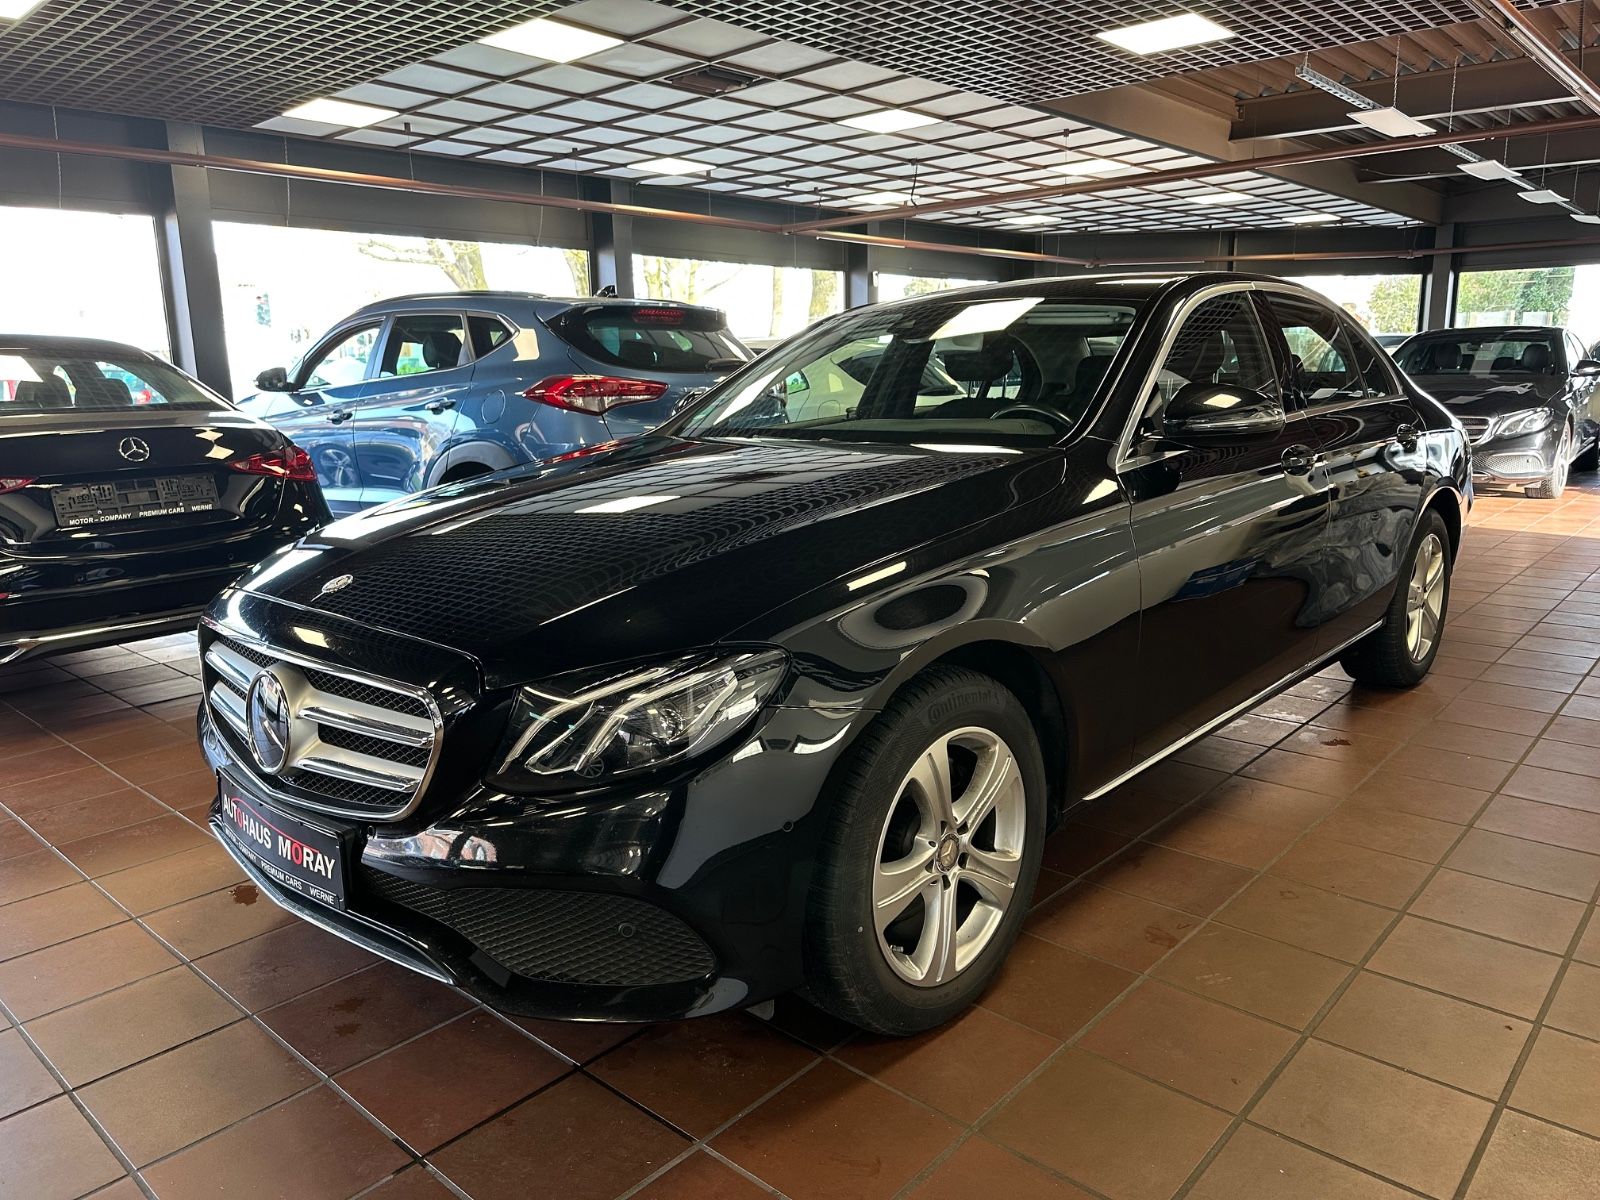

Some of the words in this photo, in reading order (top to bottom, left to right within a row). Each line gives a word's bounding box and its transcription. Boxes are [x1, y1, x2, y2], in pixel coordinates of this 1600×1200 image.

[69, 517, 94, 526] MOTOR
[100, 512, 132, 523] COMPANY
[139, 507, 167, 517] PREMIUM
[168, 506, 185, 515] CARS
[191, 503, 213, 512] WERNE
[927, 689, 992, 726] Continental
[223, 793, 272, 849] AUTOHAUS
[278, 835, 336, 879] MORAY
[260, 860, 285, 881] PREMIUM
[285, 875, 303, 890] CARS
[309, 886, 335, 904] WERNE
